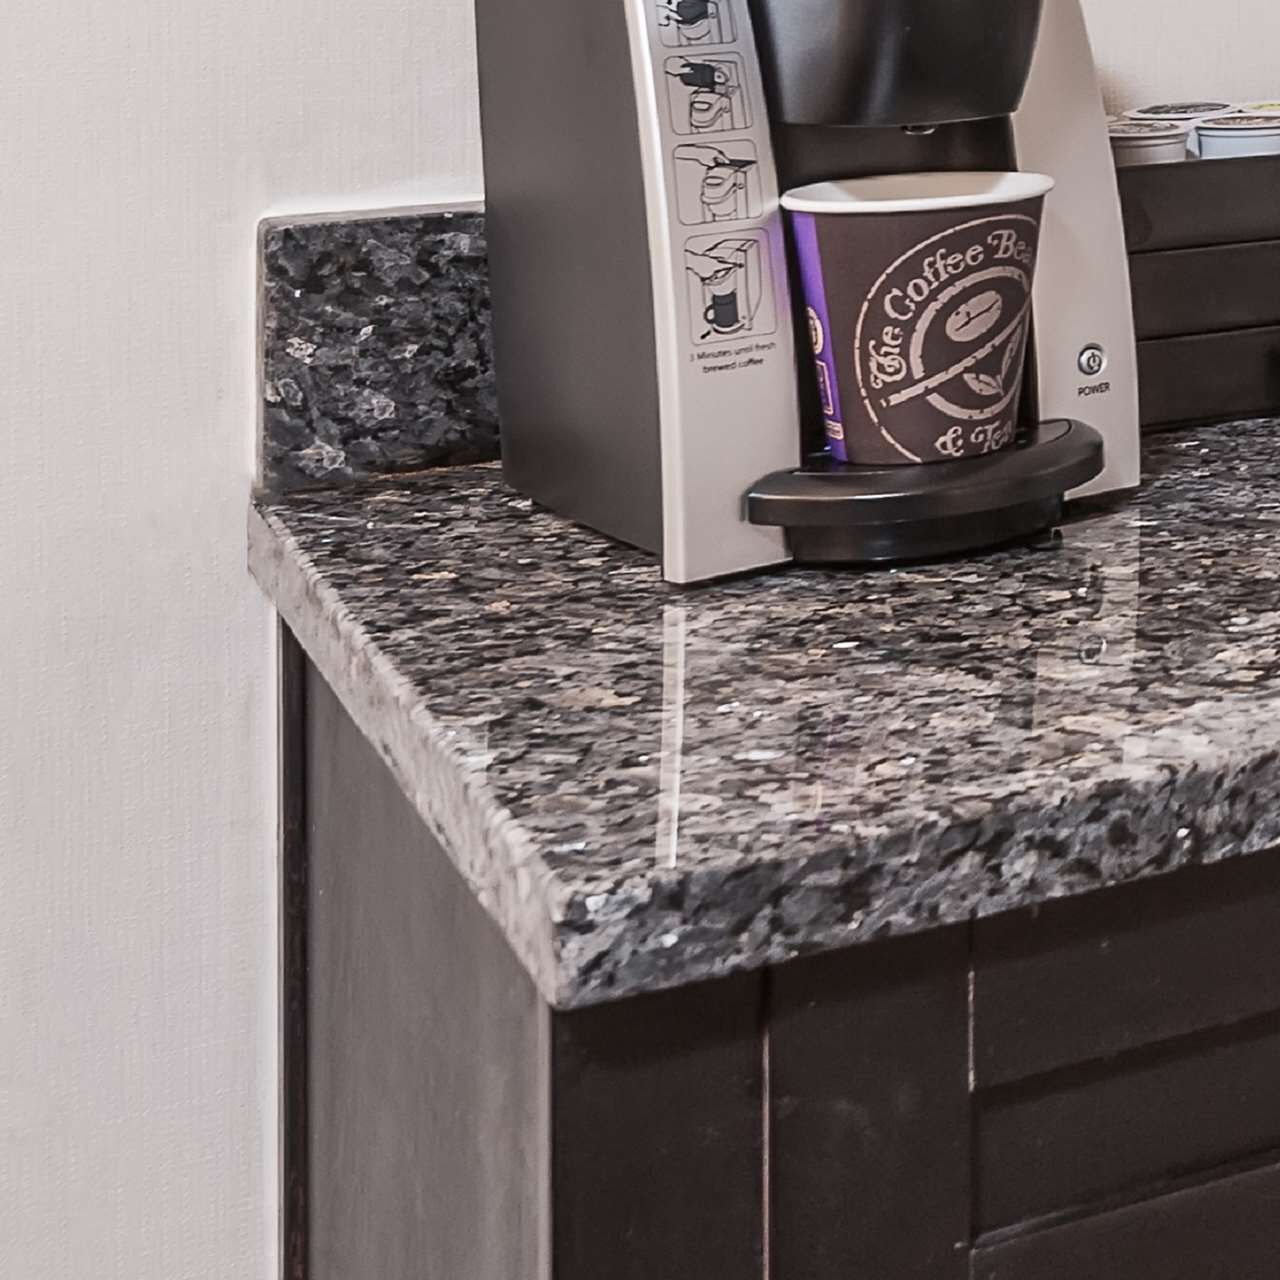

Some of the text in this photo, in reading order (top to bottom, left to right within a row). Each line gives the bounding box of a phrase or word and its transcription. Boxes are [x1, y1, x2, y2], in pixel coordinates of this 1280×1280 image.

[986, 229, 1034, 265] Bea
[884, 243, 984, 322] Coffee
[697, 350, 733, 360] Minutes
[702, 357, 764, 374] brewed coffee
[869, 325, 908, 389] The
[1077, 382, 1111, 397] POWER
[933, 426, 965, 457] &
